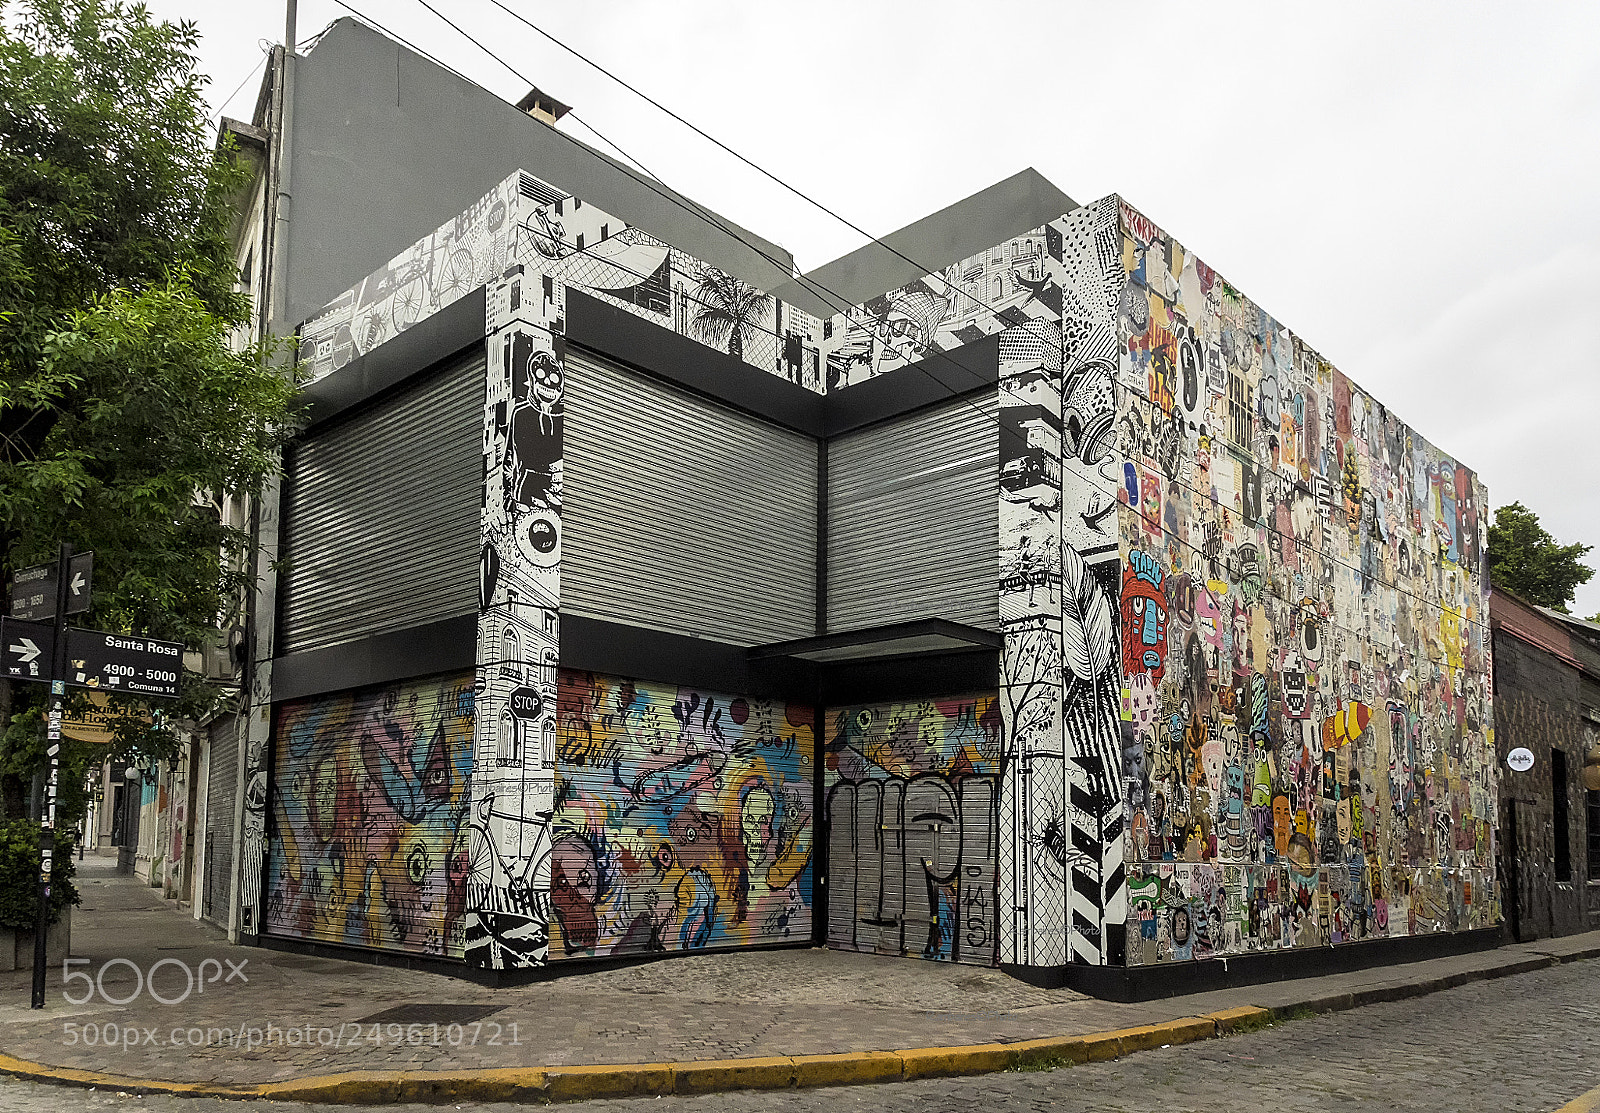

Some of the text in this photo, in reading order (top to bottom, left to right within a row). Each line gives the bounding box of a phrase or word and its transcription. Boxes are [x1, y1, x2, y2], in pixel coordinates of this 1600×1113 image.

[490, 206, 505, 227] STOP
[1228, 370, 1253, 413] VALE
[1228, 399, 1252, 451] TODO
[105, 635, 178, 656] Santa Rosa
[103, 663, 135, 677] 4900
[145, 669, 176, 682] 5000
[128, 681, 175, 694] Comuna 14
[514, 695, 539, 711] STOP
